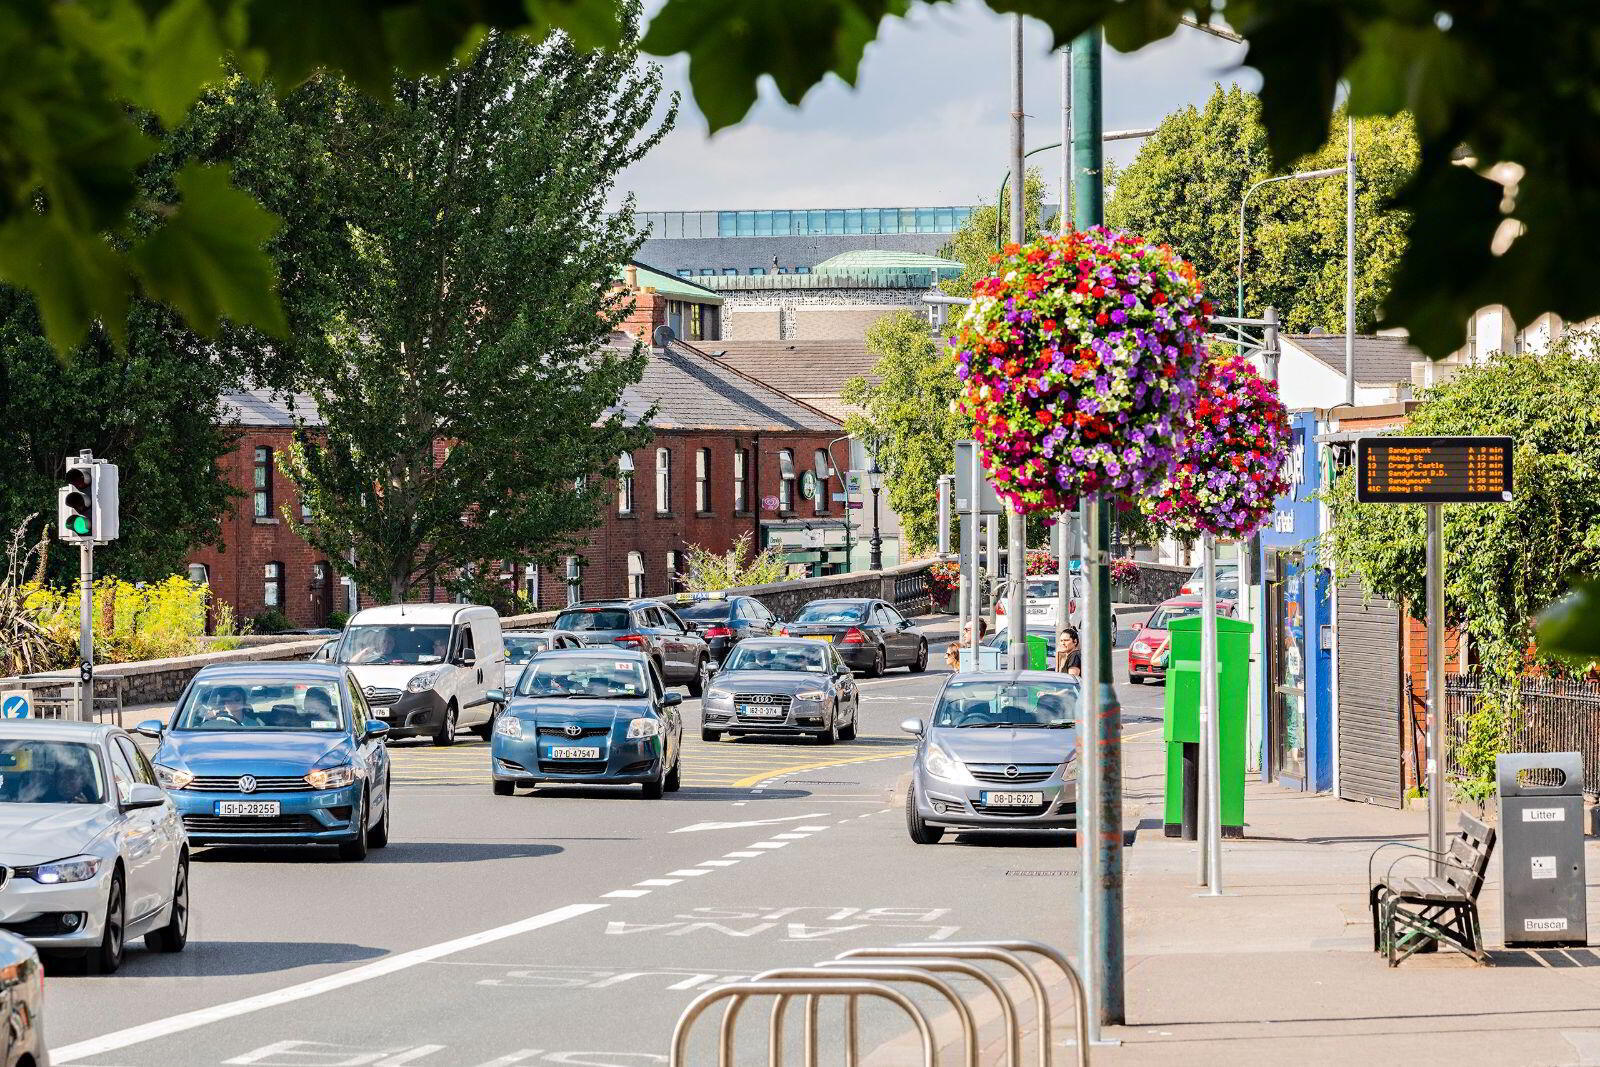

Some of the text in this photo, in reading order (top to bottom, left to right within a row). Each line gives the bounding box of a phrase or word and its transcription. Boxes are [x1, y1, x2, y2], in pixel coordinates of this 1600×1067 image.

[553, 748, 595, 758] 07-D-47547
[224, 804, 275, 814] 151-D-28255
[1530, 810, 1556, 820] Litter
[1526, 919, 1565, 931] Bruscar
